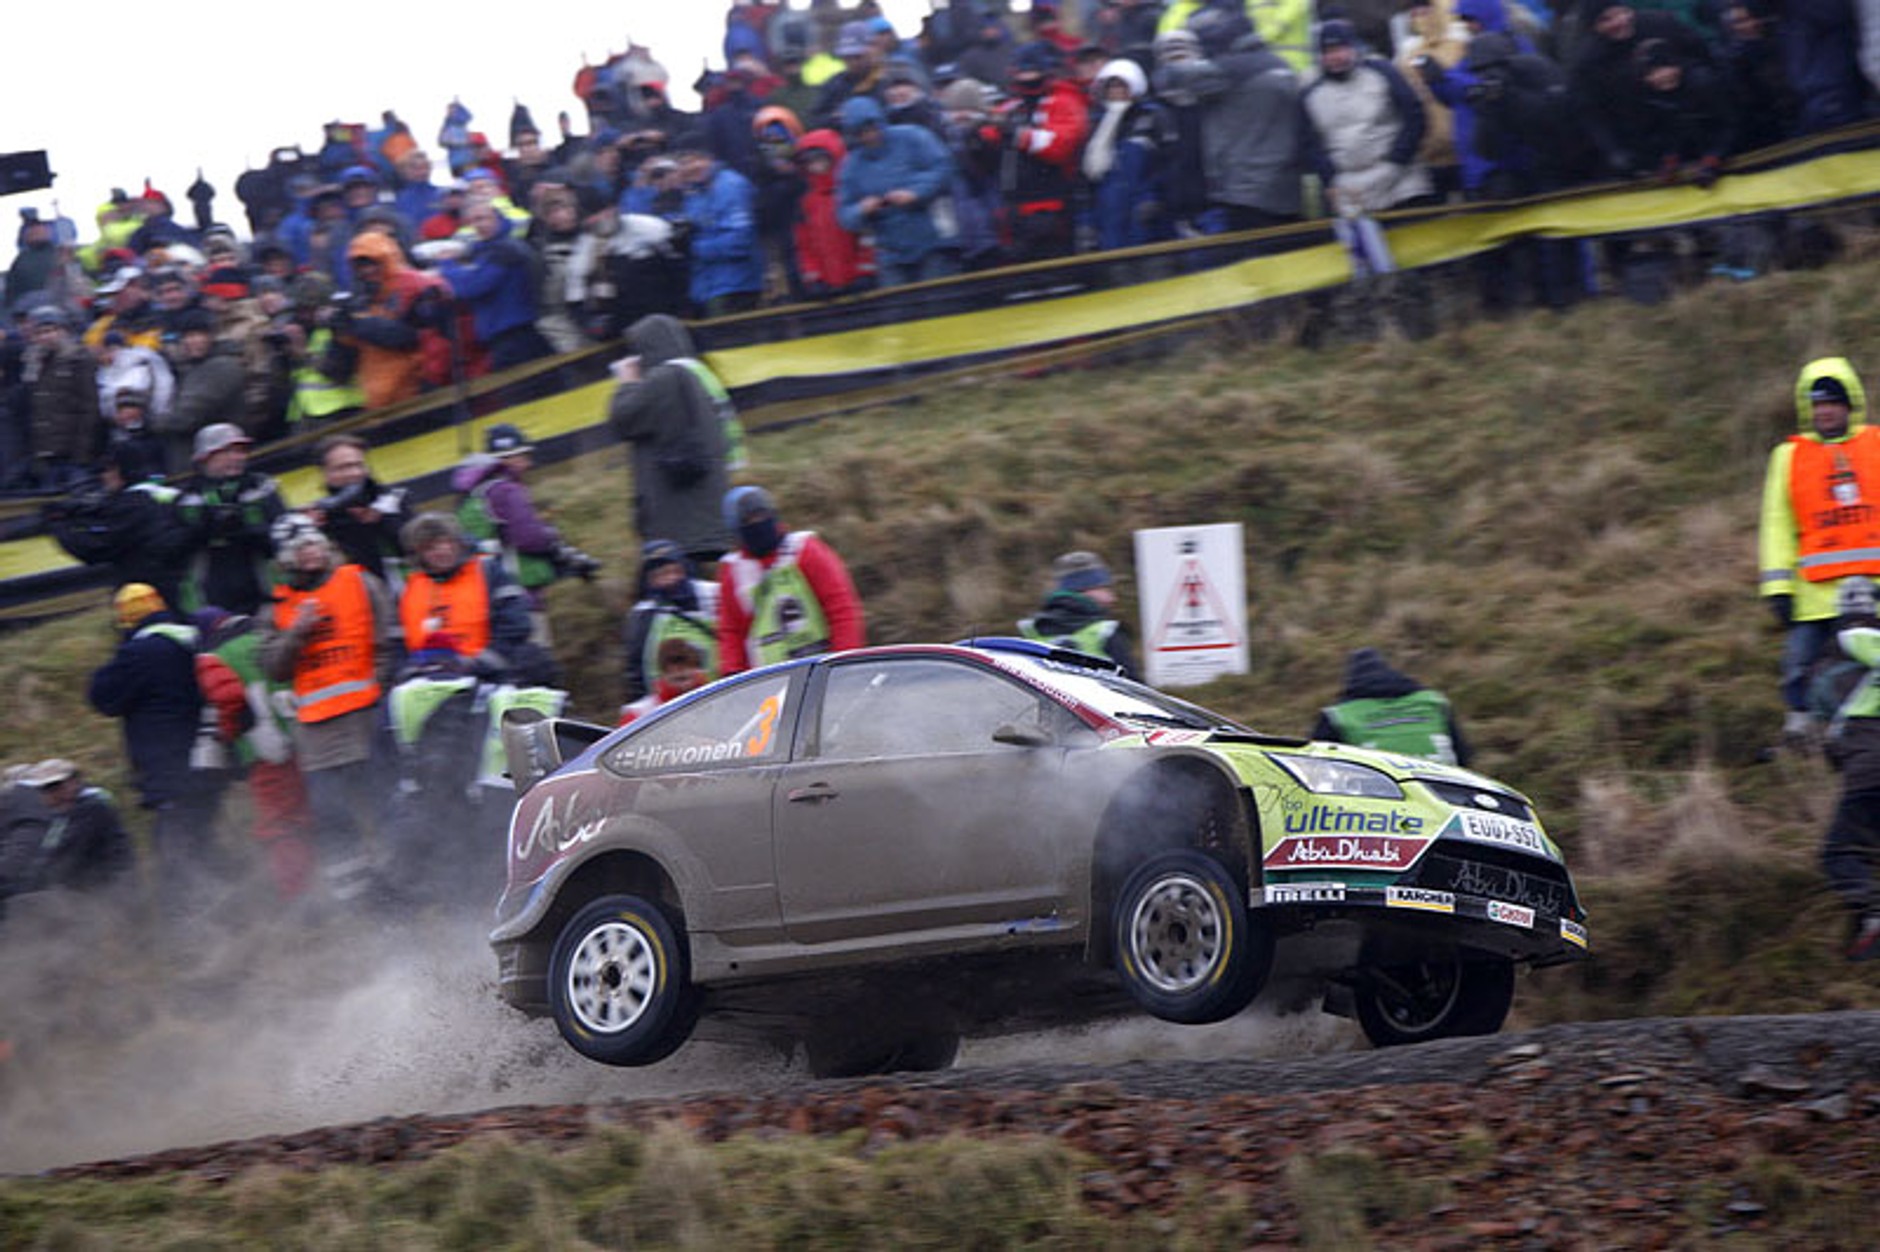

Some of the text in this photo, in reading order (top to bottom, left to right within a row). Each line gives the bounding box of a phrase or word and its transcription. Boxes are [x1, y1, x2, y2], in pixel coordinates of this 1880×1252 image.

[747, 696, 780, 757] 3
[635, 740, 743, 769] Hirvonen
[1284, 805, 1424, 835] ultimate
[1287, 838, 1400, 863] Abu Dhabi
[1449, 859, 1505, 897] Abu
